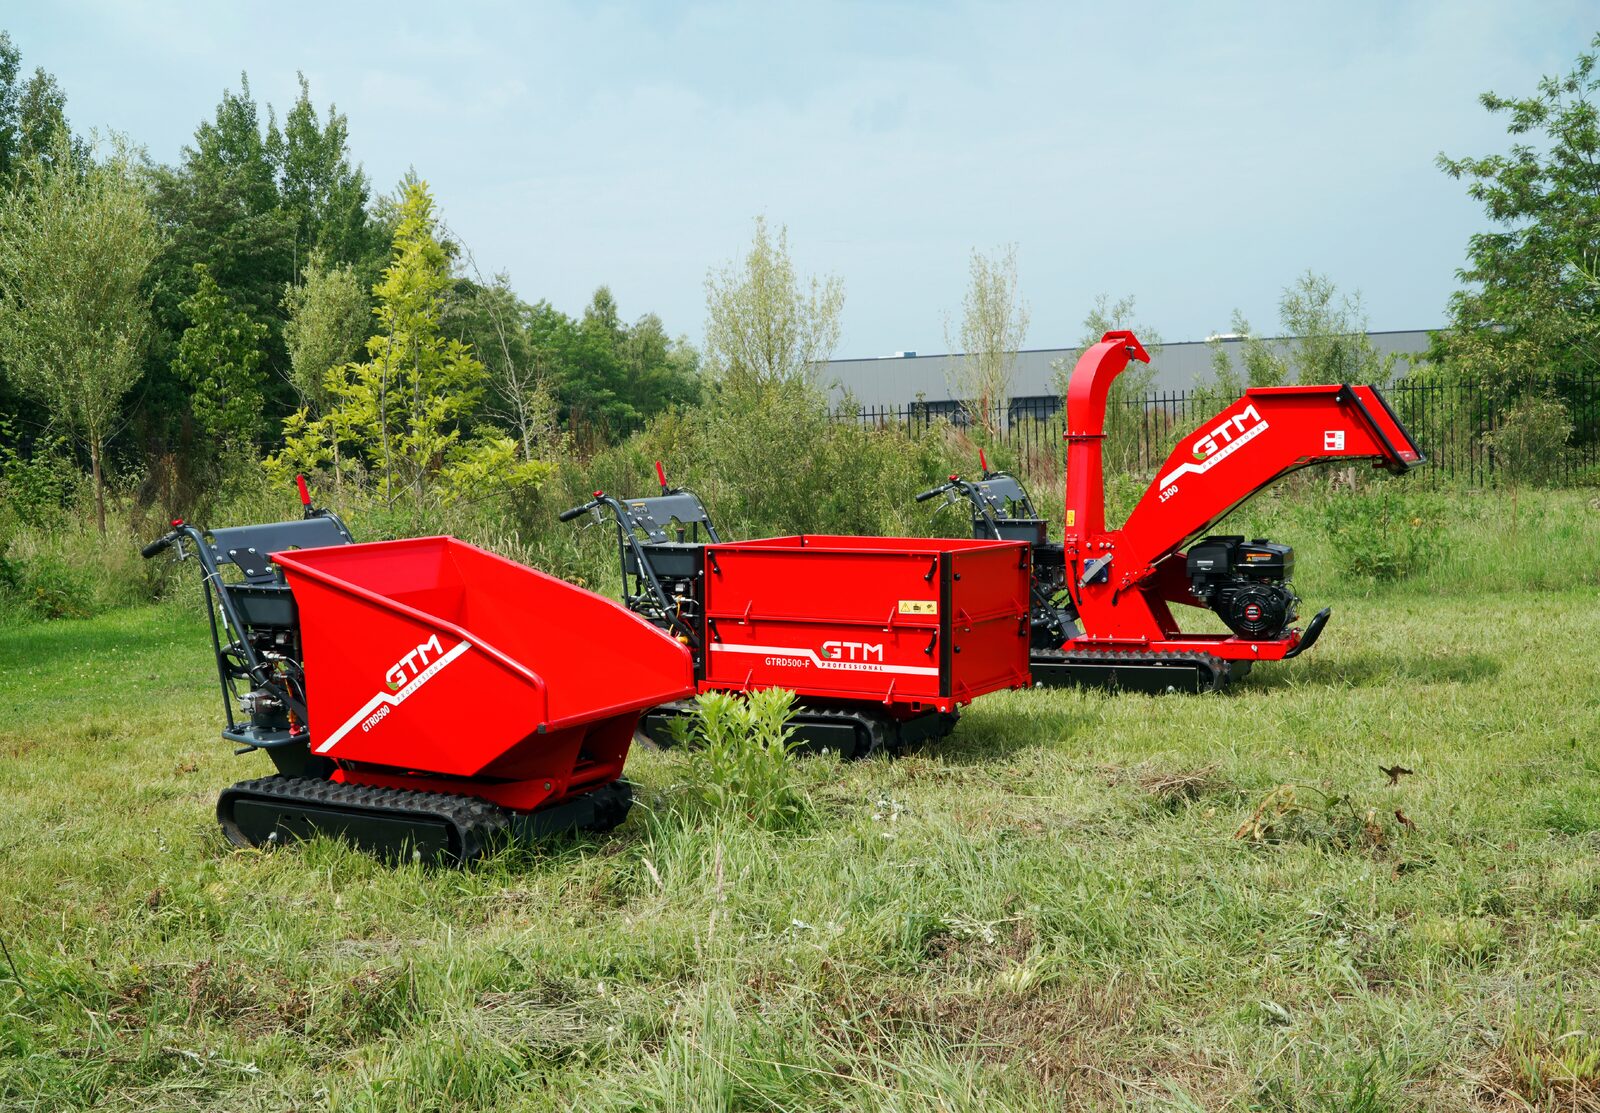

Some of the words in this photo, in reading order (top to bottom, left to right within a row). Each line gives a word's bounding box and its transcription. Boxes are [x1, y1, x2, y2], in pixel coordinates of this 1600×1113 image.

[1192, 404, 1261, 460] GTM
[1202, 423, 1266, 470] PROFESSIONAL
[1158, 484, 1179, 503] 1300
[386, 633, 444, 691] GTM
[765, 657, 810, 669] GTRD500-F
[820, 640, 883, 662] GTM
[397, 658, 449, 701] PROFESSIONAL
[821, 661, 884, 671] PROFESSIONAL
[362, 704, 391, 733] GTRD500
